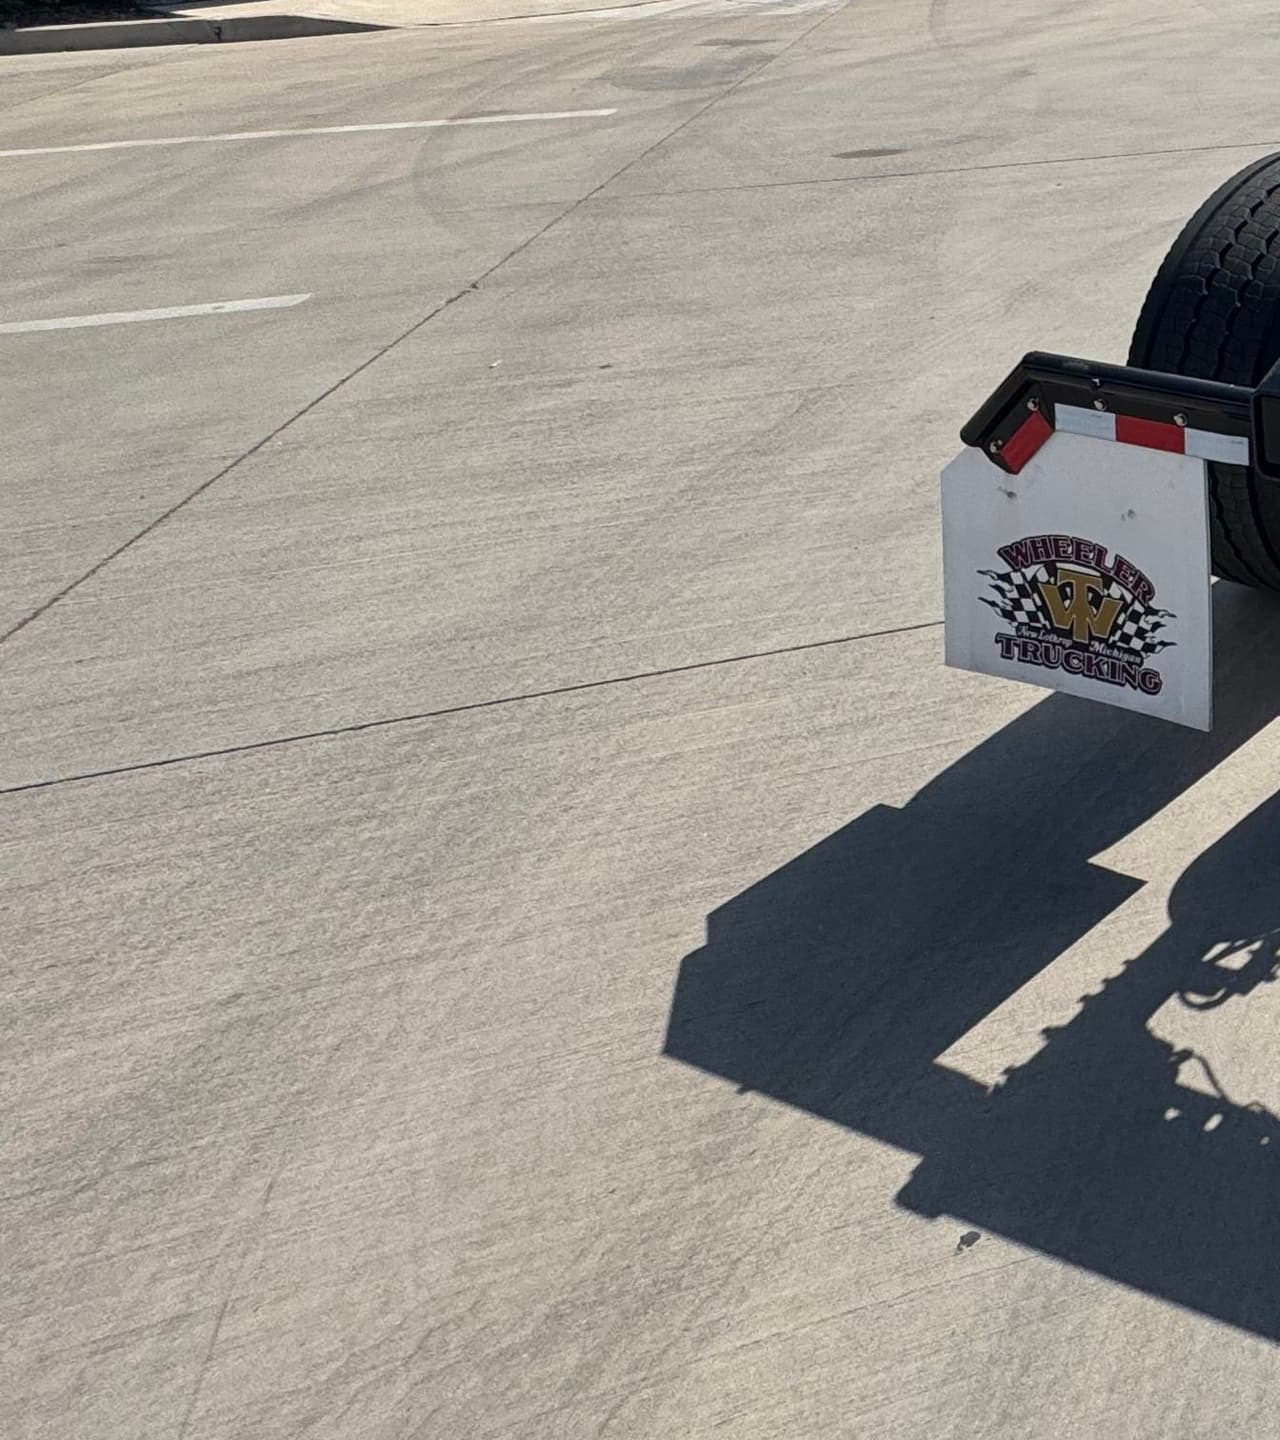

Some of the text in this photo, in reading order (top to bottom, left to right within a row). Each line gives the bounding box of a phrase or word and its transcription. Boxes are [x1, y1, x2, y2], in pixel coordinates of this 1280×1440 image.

[997, 534, 1156, 606] WHEELER
[995, 632, 1163, 696] TRUCKING
[1089, 641, 1143, 663] Michigan
